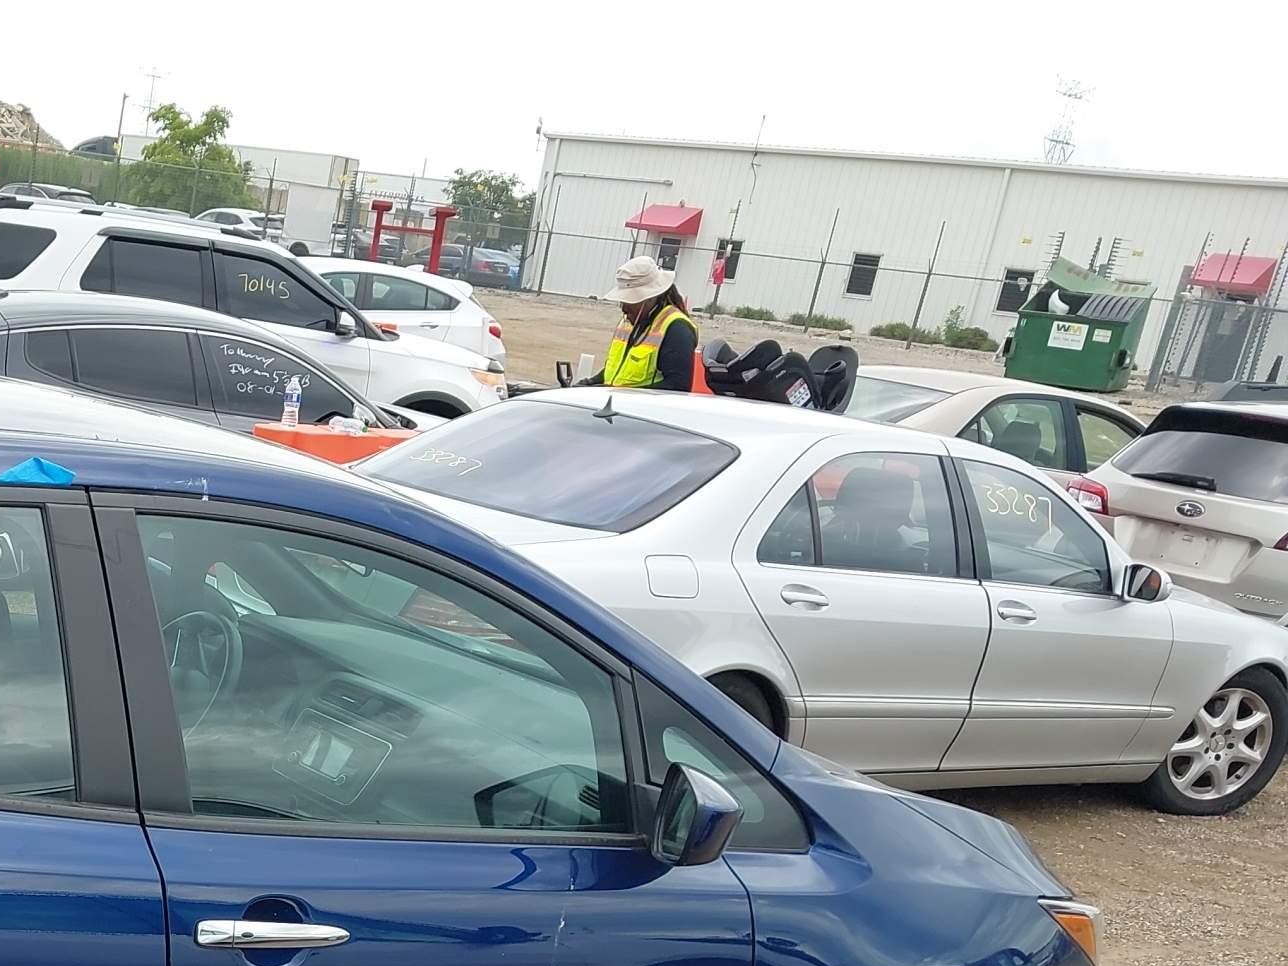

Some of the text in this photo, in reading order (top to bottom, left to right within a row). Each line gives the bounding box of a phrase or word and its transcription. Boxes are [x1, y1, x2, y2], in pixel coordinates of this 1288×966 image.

[237, 273, 290, 299] 70145
[1056, 323, 1082, 334] WM
[408, 447, 483, 477] 33287
